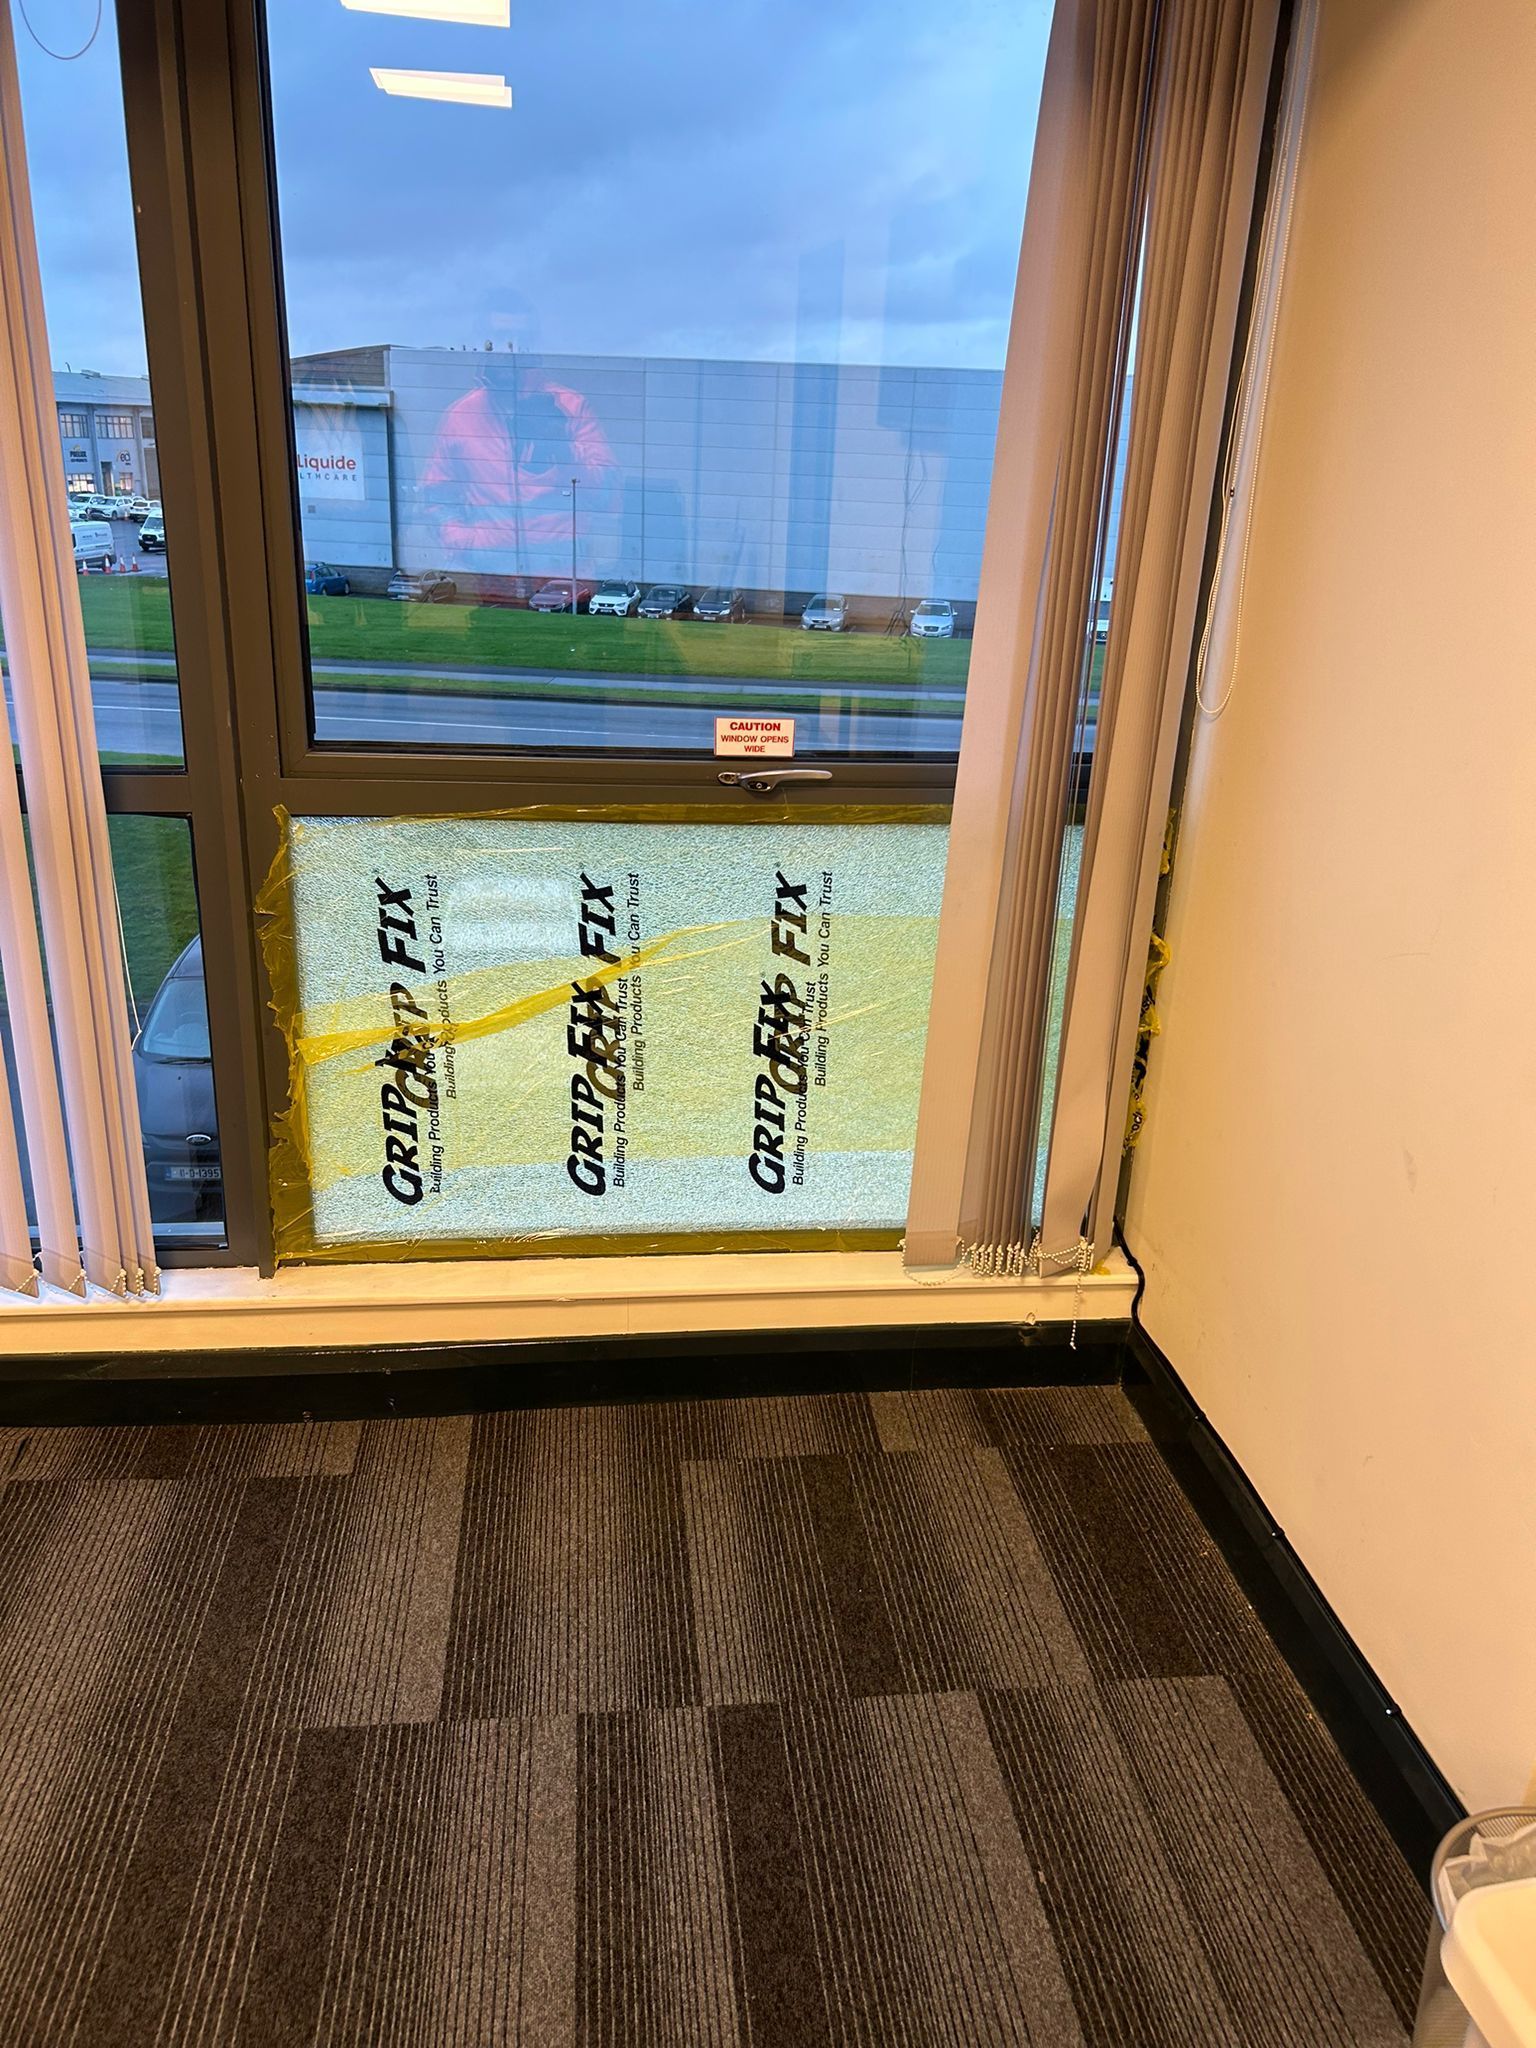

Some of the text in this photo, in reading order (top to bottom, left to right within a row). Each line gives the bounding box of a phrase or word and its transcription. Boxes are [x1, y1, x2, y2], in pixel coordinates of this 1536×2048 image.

[297, 453, 357, 472] Liquide
[299, 472, 358, 482] LTHCARE
[720, 734, 790, 744] WINDOW OPENS
[729, 721, 782, 732] CAUTION
[744, 745, 766, 753] WIDE
[425, 873, 440, 911] Trust
[626, 872, 640, 910] Trust
[375, 876, 427, 974] FIX
[429, 916, 443, 945] Can
[578, 871, 622, 968] FIX
[627, 913, 640, 942] Can
[770, 870, 811, 967] FIX
[433, 949, 447, 975] You
[815, 871, 833, 1087] Building Products You Can Trust
[615, 977, 629, 1011] Trust
[630, 974, 643, 1036] Products
[802, 980, 817, 1014] Trust
[424, 1052, 437, 1076] You
[444, 1043, 457, 1099] Building
[614, 1046, 627, 1070] You
[632, 1039, 646, 1092] Building
[613, 1074, 627, 1133] Products
[794, 1074, 809, 1132] Products
[380, 1083, 424, 1206] GRIP
[566, 1073, 607, 1197] GRIP
[748, 1073, 786, 1195] GRIP
[613, 1136, 629, 1188] Building
[792, 1135, 809, 1186] Building
